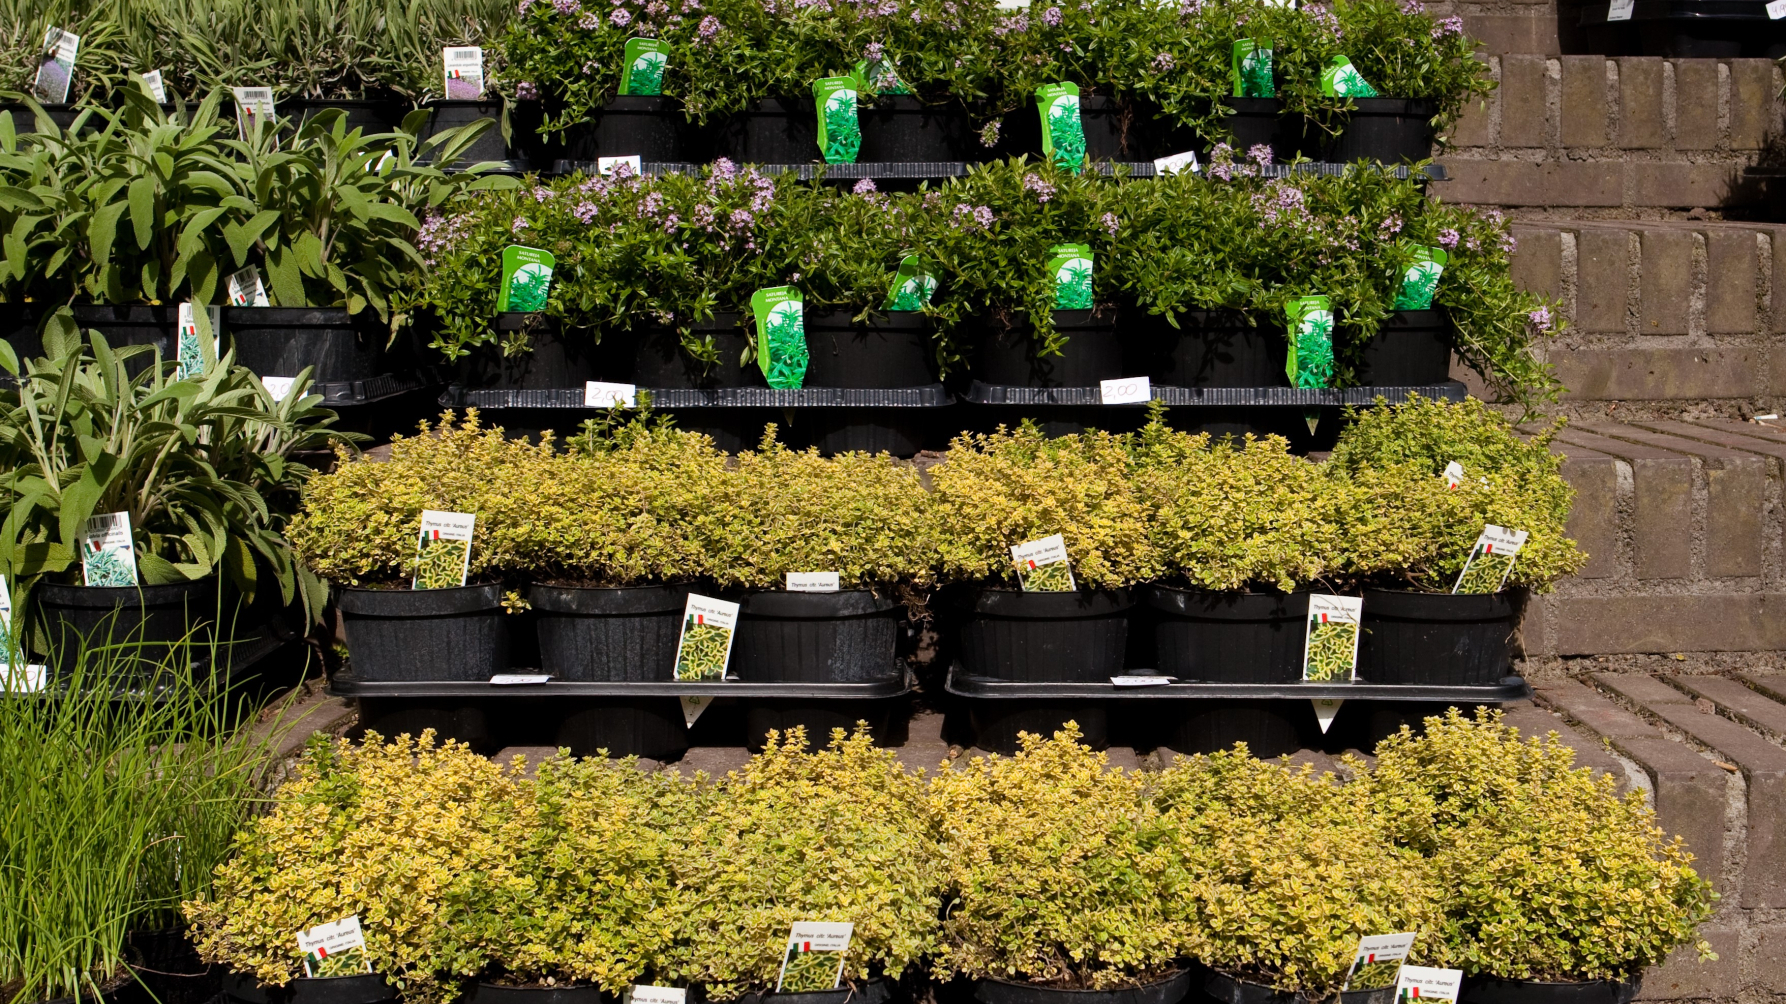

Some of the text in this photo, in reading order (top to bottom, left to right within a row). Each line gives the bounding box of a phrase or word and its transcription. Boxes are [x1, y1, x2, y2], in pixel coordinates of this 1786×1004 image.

[591, 387, 624, 404] 2,00
[1103, 384, 1137, 400] 2,00
[305, 937, 324, 948] Thymus
[1404, 976, 1423, 985] Thymus
